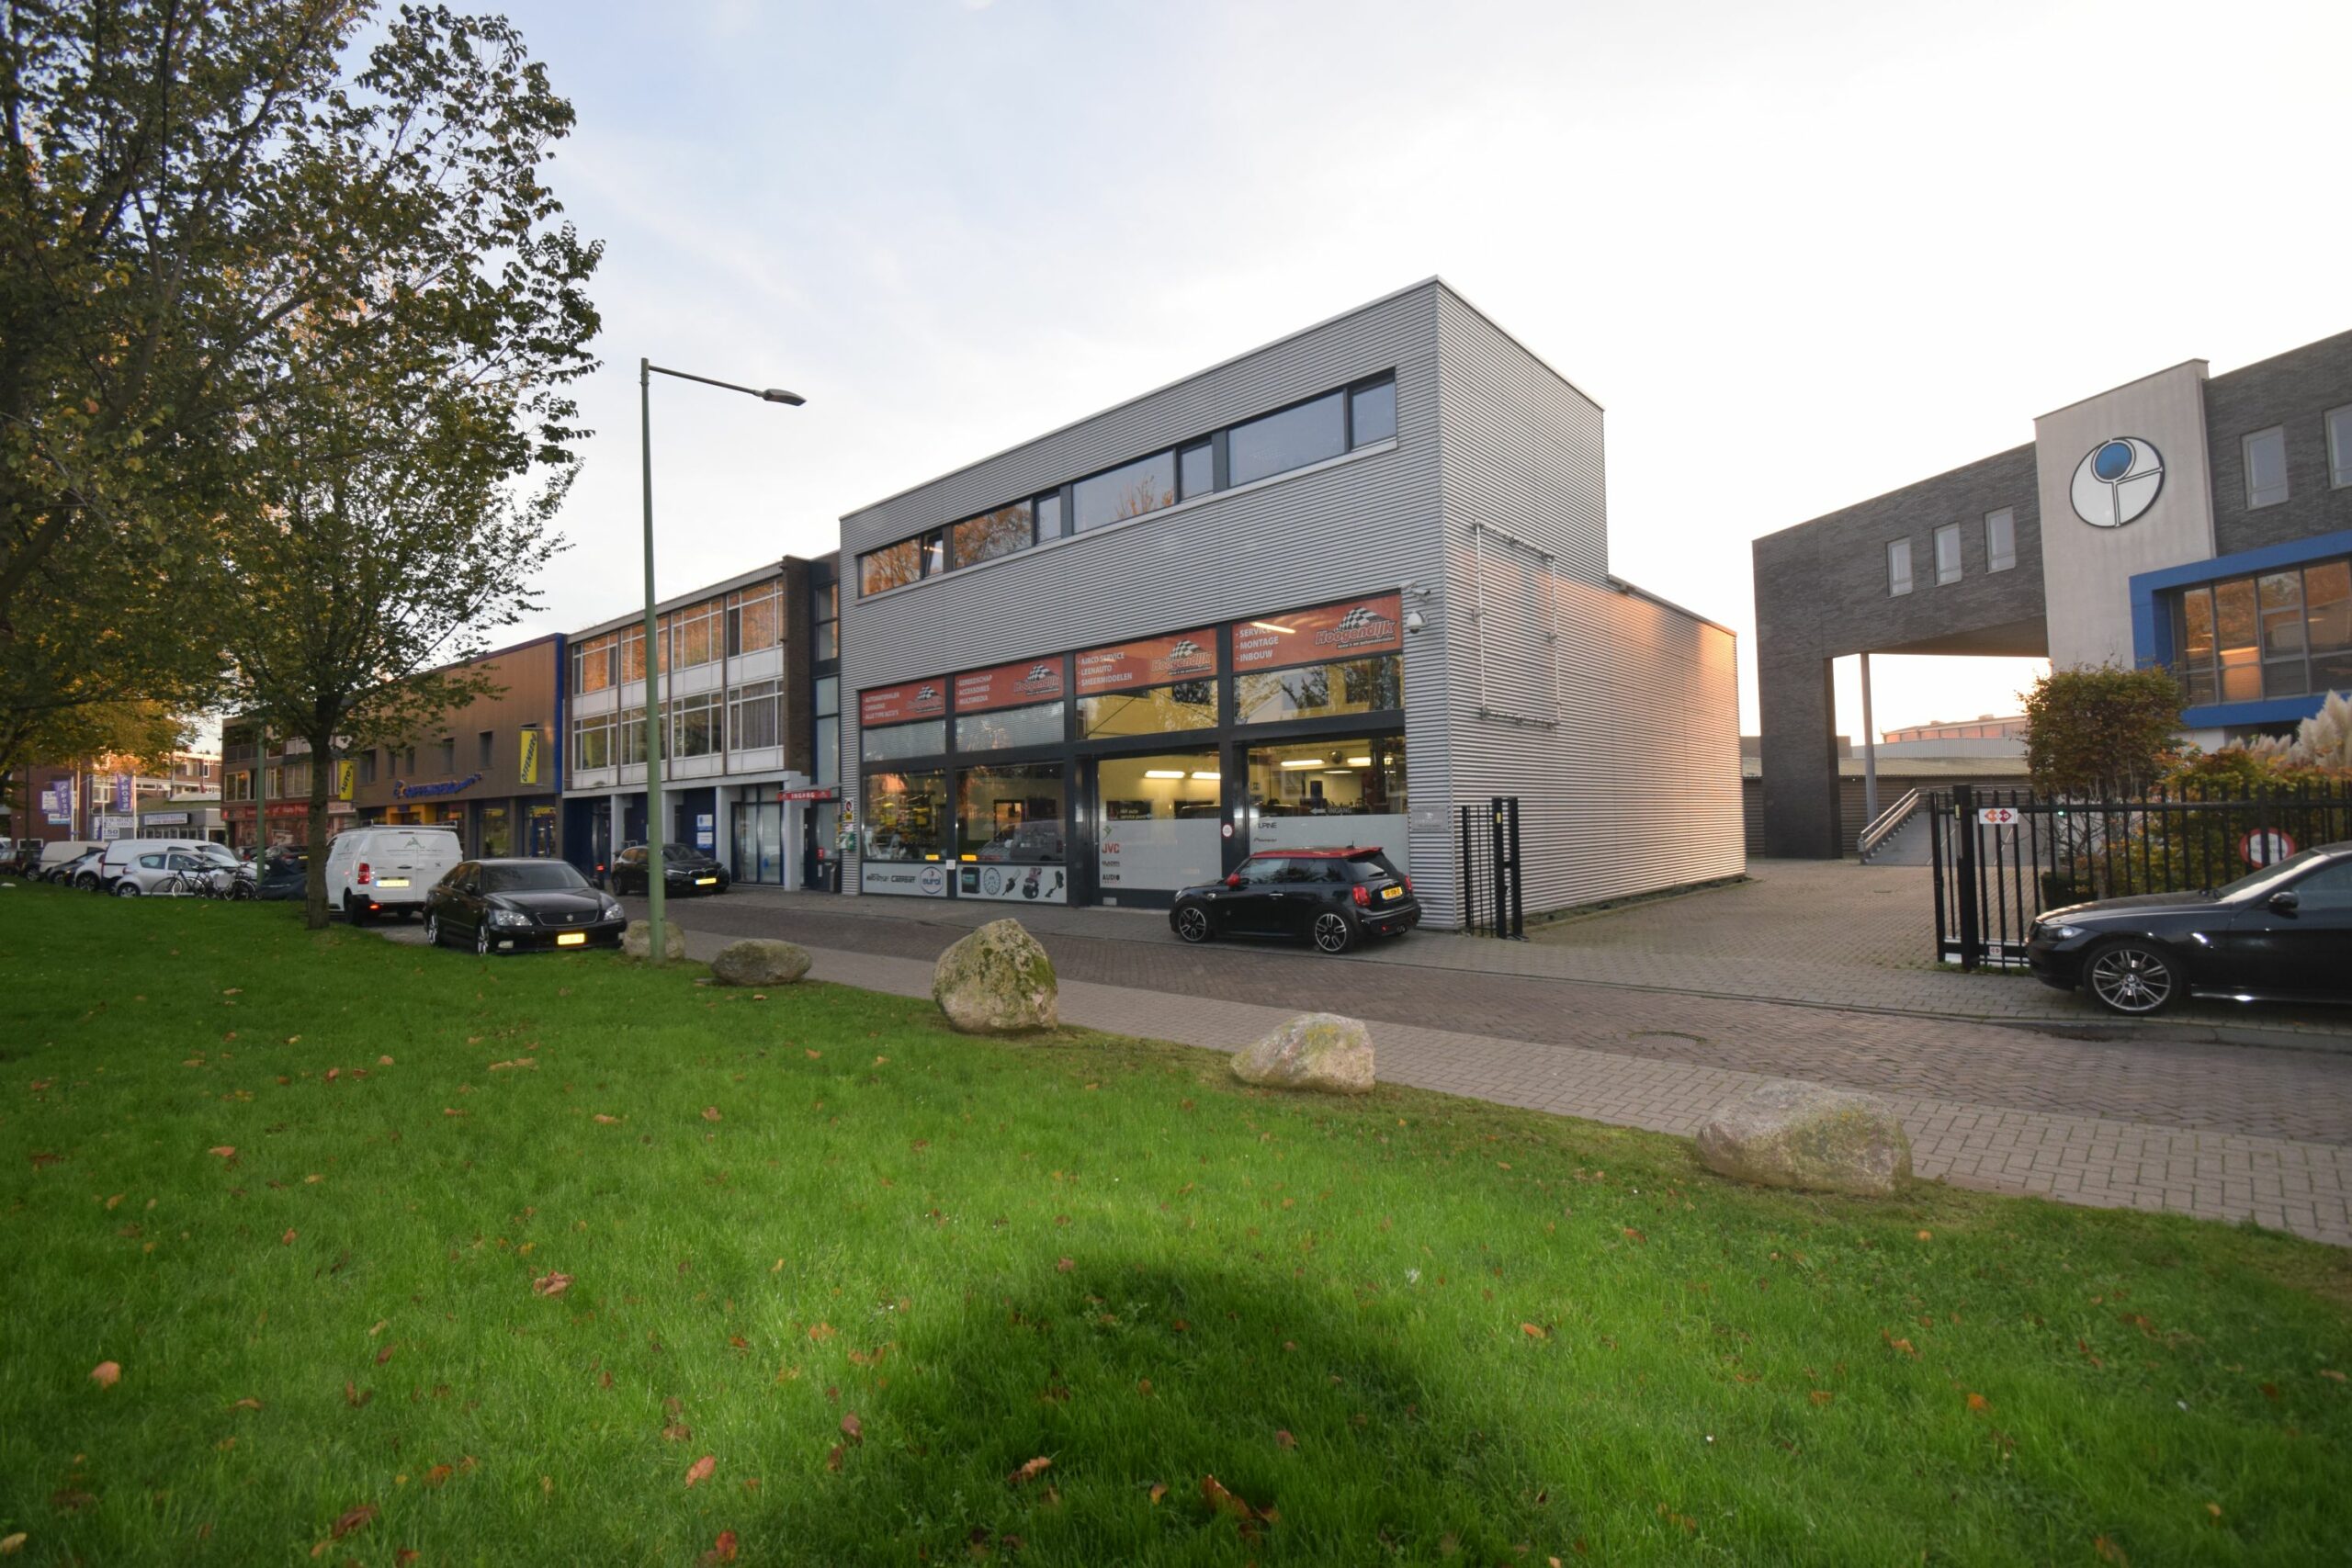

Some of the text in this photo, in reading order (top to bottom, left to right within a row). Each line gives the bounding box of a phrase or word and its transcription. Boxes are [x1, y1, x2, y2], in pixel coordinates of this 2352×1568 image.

[1316, 620, 1396, 646] Hoogendijk
[1240, 636, 1279, 649] MONTAGE
[1081, 656, 1099, 665] AIRCO
[1240, 649, 1272, 661] INBOUW
[1080, 664, 1112, 676] LEENAUTO
[1081, 671, 1133, 687] SMEERMIDDELEN
[1102, 843, 1120, 853] JVC
